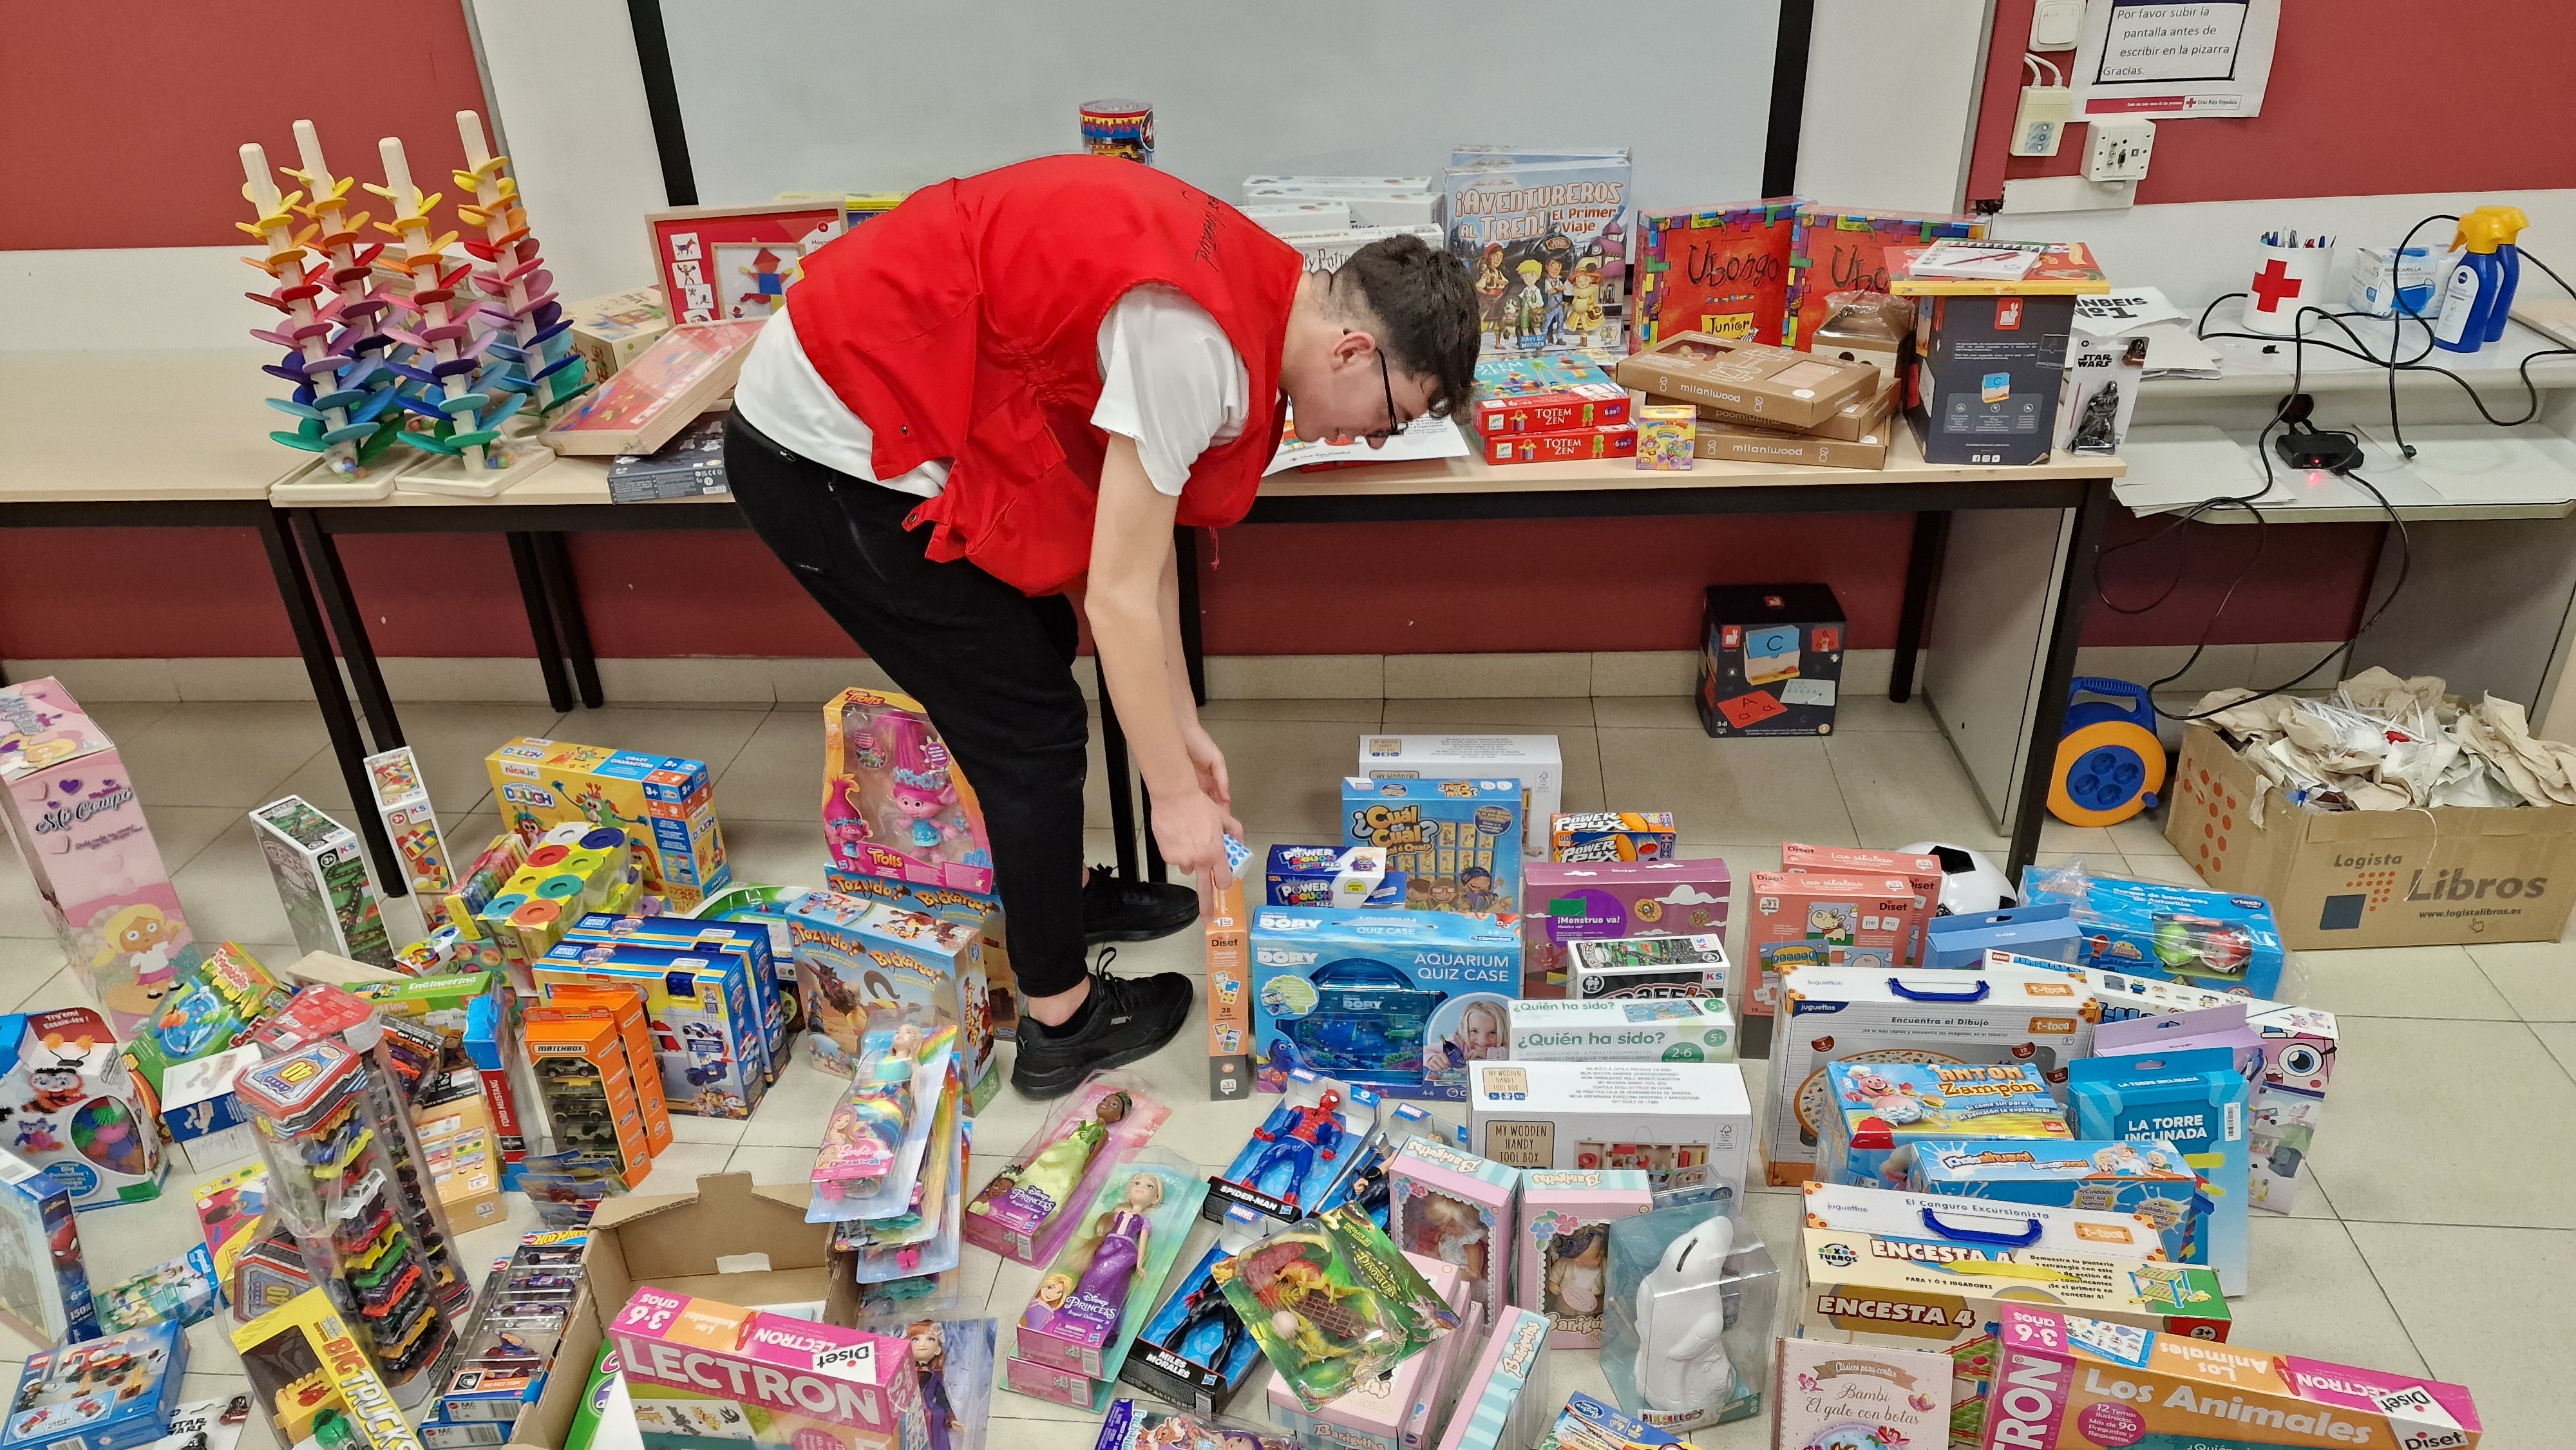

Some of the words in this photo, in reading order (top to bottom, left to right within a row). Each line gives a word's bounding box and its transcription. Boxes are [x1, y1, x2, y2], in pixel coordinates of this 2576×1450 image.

[2117, 9, 2136, 19] Por
[2139, 8, 2166, 19] favor
[2170, 7, 2197, 17] subir
[2201, 6, 2210, 16] la
[2123, 27, 2166, 40] pantalla
[2202, 25, 2217, 35] de
[2120, 46, 2159, 57] escribir
[2179, 45, 2188, 55] la
[2191, 45, 2230, 56] pizarra
[2103, 66, 2145, 76] Gracias.
[1552, 209, 1565, 221] El
[1568, 206, 1616, 219] Primer
[1460, 223, 1478, 239] AL
[1481, 209, 1546, 241] TREN!
[1560, 221, 1596, 235] Viaje
[1687, 240, 1779, 287] Ubongo
[2078, 360, 2112, 368] WARS
[2081, 353, 2113, 362] STAR
[1680, 384, 1741, 402] milaniwood
[1535, 408, 1572, 419] TOTEM
[1545, 417, 1565, 425] ZEN
[1544, 438, 1582, 448] TOTEM
[1555, 447, 1575, 455] ZEN
[1732, 444, 1803, 457] milaniwood
[846, 691, 884, 706] Trolls
[503, 784, 554, 807] DOUGH
[35, 809, 70, 834] Mi
[75, 786, 133, 822] Compi
[410, 804, 427, 815] KS
[1390, 823, 1405, 831] es
[1554, 813, 1619, 830] POWER
[340, 843, 355, 854] KS
[1283, 847, 1334, 860] POWER
[1561, 841, 1616, 861] POWER
[868, 850, 903, 867] Trolls
[1292, 856, 1337, 865] DOUGH
[1832, 852, 1850, 862] Las
[2334, 852, 2403, 870] Logista
[1282, 882, 1329, 897] POWER
[1801, 878, 1821, 887] Las
[2408, 868, 2548, 903] Libros
[1291, 891, 1334, 905] DOUGH
[1879, 902, 1909, 912] Diset
[2419, 907, 2522, 919] www.logistalibros.es
[1260, 917, 1322, 931] DORY
[1357, 926, 1387, 936] QUIZ
[1390, 926, 1416, 936] CASE
[1211, 937, 1238, 947] Diset
[1256, 951, 1319, 965] DORY
[1414, 953, 1509, 967] AQUARIUM
[1418, 968, 1459, 981] QUIZ
[1464, 969, 1509, 982] CASE
[1706, 972, 1723, 981] KS
[408, 975, 477, 990] Engineering
[2031, 985, 2067, 993] t-toca
[1343, 1000, 1383, 1010] DORY
[1513, 1002, 1558, 1012] ¿Quién
[1582, 1001, 1615, 1010] sido?
[1946, 1017, 1955, 1026] el
[1957, 1019, 1989, 1028] Dibujo
[2036, 1021, 2070, 1030] t-toca
[1517, 1032, 1583, 1049] ¿Quién
[1588, 1032, 1611, 1045] ha
[1617, 1031, 1666, 1045] sido?
[1710, 1034, 1723, 1043] 5+
[537, 1044, 583, 1053] MATCHBOX
[1293, 1069, 1315, 1081] MARVEL
[1938, 1066, 2025, 1082] ANTÓN
[1938, 1081, 2043, 1098] Zampón
[1398, 1103, 1423, 1118] MARVEL
[2128, 1120, 2148, 1131] LA
[2152, 1115, 2204, 1129] TORRE
[1495, 1125, 1509, 1137] MY
[1510, 1125, 1547, 1137] WOODEN
[2125, 1127, 2208, 1142] INCLINADA
[837, 1144, 874, 1159] Barbie
[1505, 1139, 1534, 1150] HANDY
[1408, 1140, 1483, 1174] Barriguitas
[1499, 1152, 1520, 1163] TOOL
[1523, 1152, 1539, 1163] BOX
[1531, 1171, 1602, 1188] Barriguitas
[1010, 1189, 1055, 1211] PRINCESS
[1028, 1185, 1050, 1201] Disney
[1220, 1185, 1278, 1211] SPIDER-MAN
[1229, 1205, 1256, 1222] MARVEL
[1827, 1202, 1868, 1214] juguettos
[1971, 1205, 2050, 1219] Excursionista
[2081, 1227, 2126, 1239] t-toca
[2030, 1255, 2070, 1264] Demuestra
[1358, 1253, 1396, 1299] DINOSAURS
[1949, 1281, 1993, 1290] JUGADORES
[2070, 1285, 2101, 1293] primero
[1083, 1291, 1109, 1306] Disney
[1064, 1296, 1117, 1319] PRINCESS
[1817, 1295, 1949, 1326] ENCESTA
[1952, 1309, 1976, 1328] 4
[2197, 1328, 2213, 1338] 3+
[323, 1337, 366, 1376] BIG
[817, 1345, 870, 1368] Diset
[1502, 1320, 1542, 1379] Barriguitas
[1159, 1351, 1188, 1368] MILES
[2159, 1342, 2268, 1375] Animales
[1146, 1353, 1191, 1379] MORALES
[1835, 1361, 1860, 1372] Clásicos
[1860, 1365, 1876, 1374] para
[1877, 1368, 1898, 1377] contar
[2199, 1361, 2236, 1381] Los
[619, 1337, 882, 1434] LECTRON
[1834, 1382, 1890, 1402] Bambi
[2085, 1368, 2154, 1402] Los
[2163, 1384, 2373, 1444] Animales
[2380, 1390, 2431, 1413] Diset
[1806, 1396, 1823, 1413] El
[1824, 1404, 1853, 1420] gato
[1858, 1409, 1882, 1420] con
[1884, 1405, 1920, 1425] botas
[2097, 1404, 2110, 1413] 12
[2112, 1408, 2136, 1418] Temas
[2089, 1418, 2104, 1426] Más
[2118, 1422, 2137, 1431] 90
[2096, 1413, 2134, 1424] ilustrados.
[2088, 1425, 2127, 1436] Preguntas
[2405, 1431, 2463, 1450] Diset
